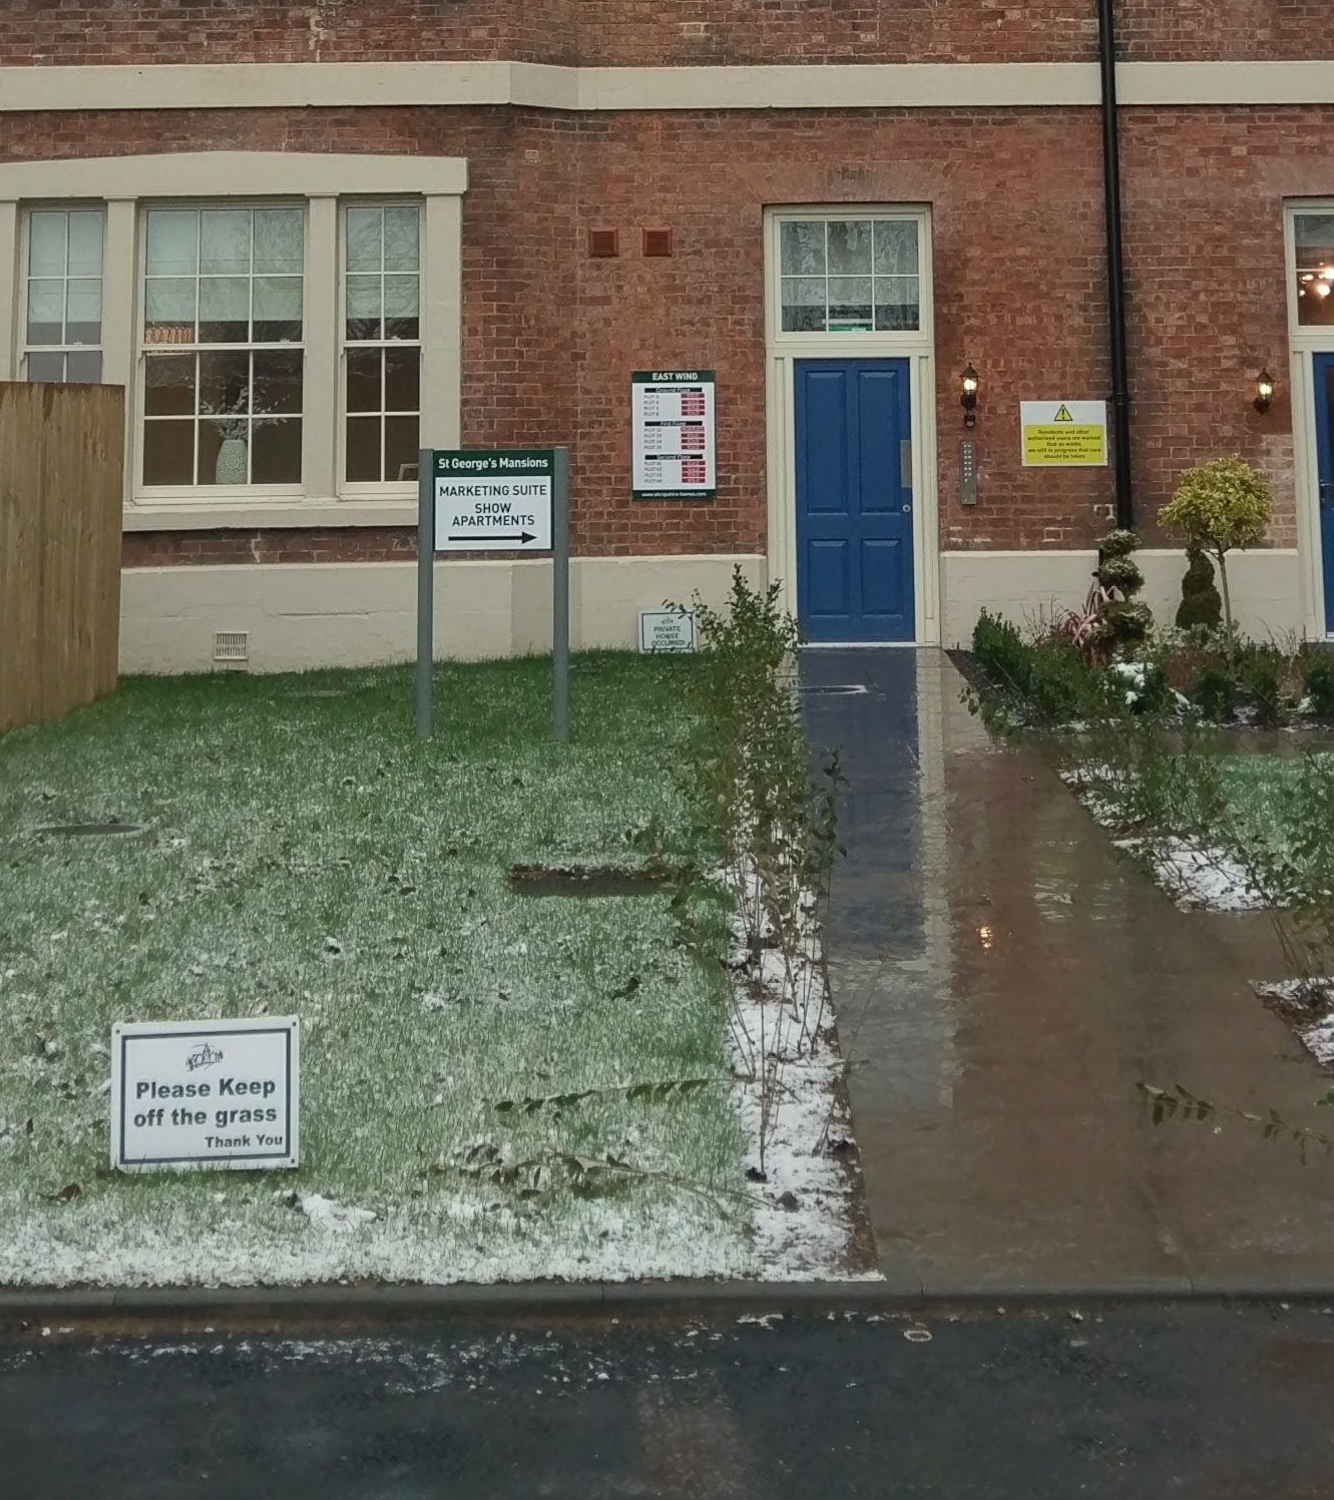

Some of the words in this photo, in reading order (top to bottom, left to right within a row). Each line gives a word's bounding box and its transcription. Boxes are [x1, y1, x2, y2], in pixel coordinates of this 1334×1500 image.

[652, 372, 673, 380] EAST
[674, 372, 698, 380] WING
[438, 458, 450, 469] St
[451, 457, 498, 471] George's
[499, 457, 549, 468] Mansions
[439, 485, 510, 497] MARKETING
[512, 484, 547, 496] SUITE
[474, 502, 512, 514] SHOW
[451, 514, 535, 527] APARTMENTS
[136, 1081, 211, 1100] Please
[219, 1077, 276, 1099] Keep
[133, 1108, 165, 1127] off
[171, 1108, 207, 1126] the
[215, 1108, 277, 1129] grass
[204, 1134, 251, 1149] Thank
[255, 1133, 283, 1146] You
